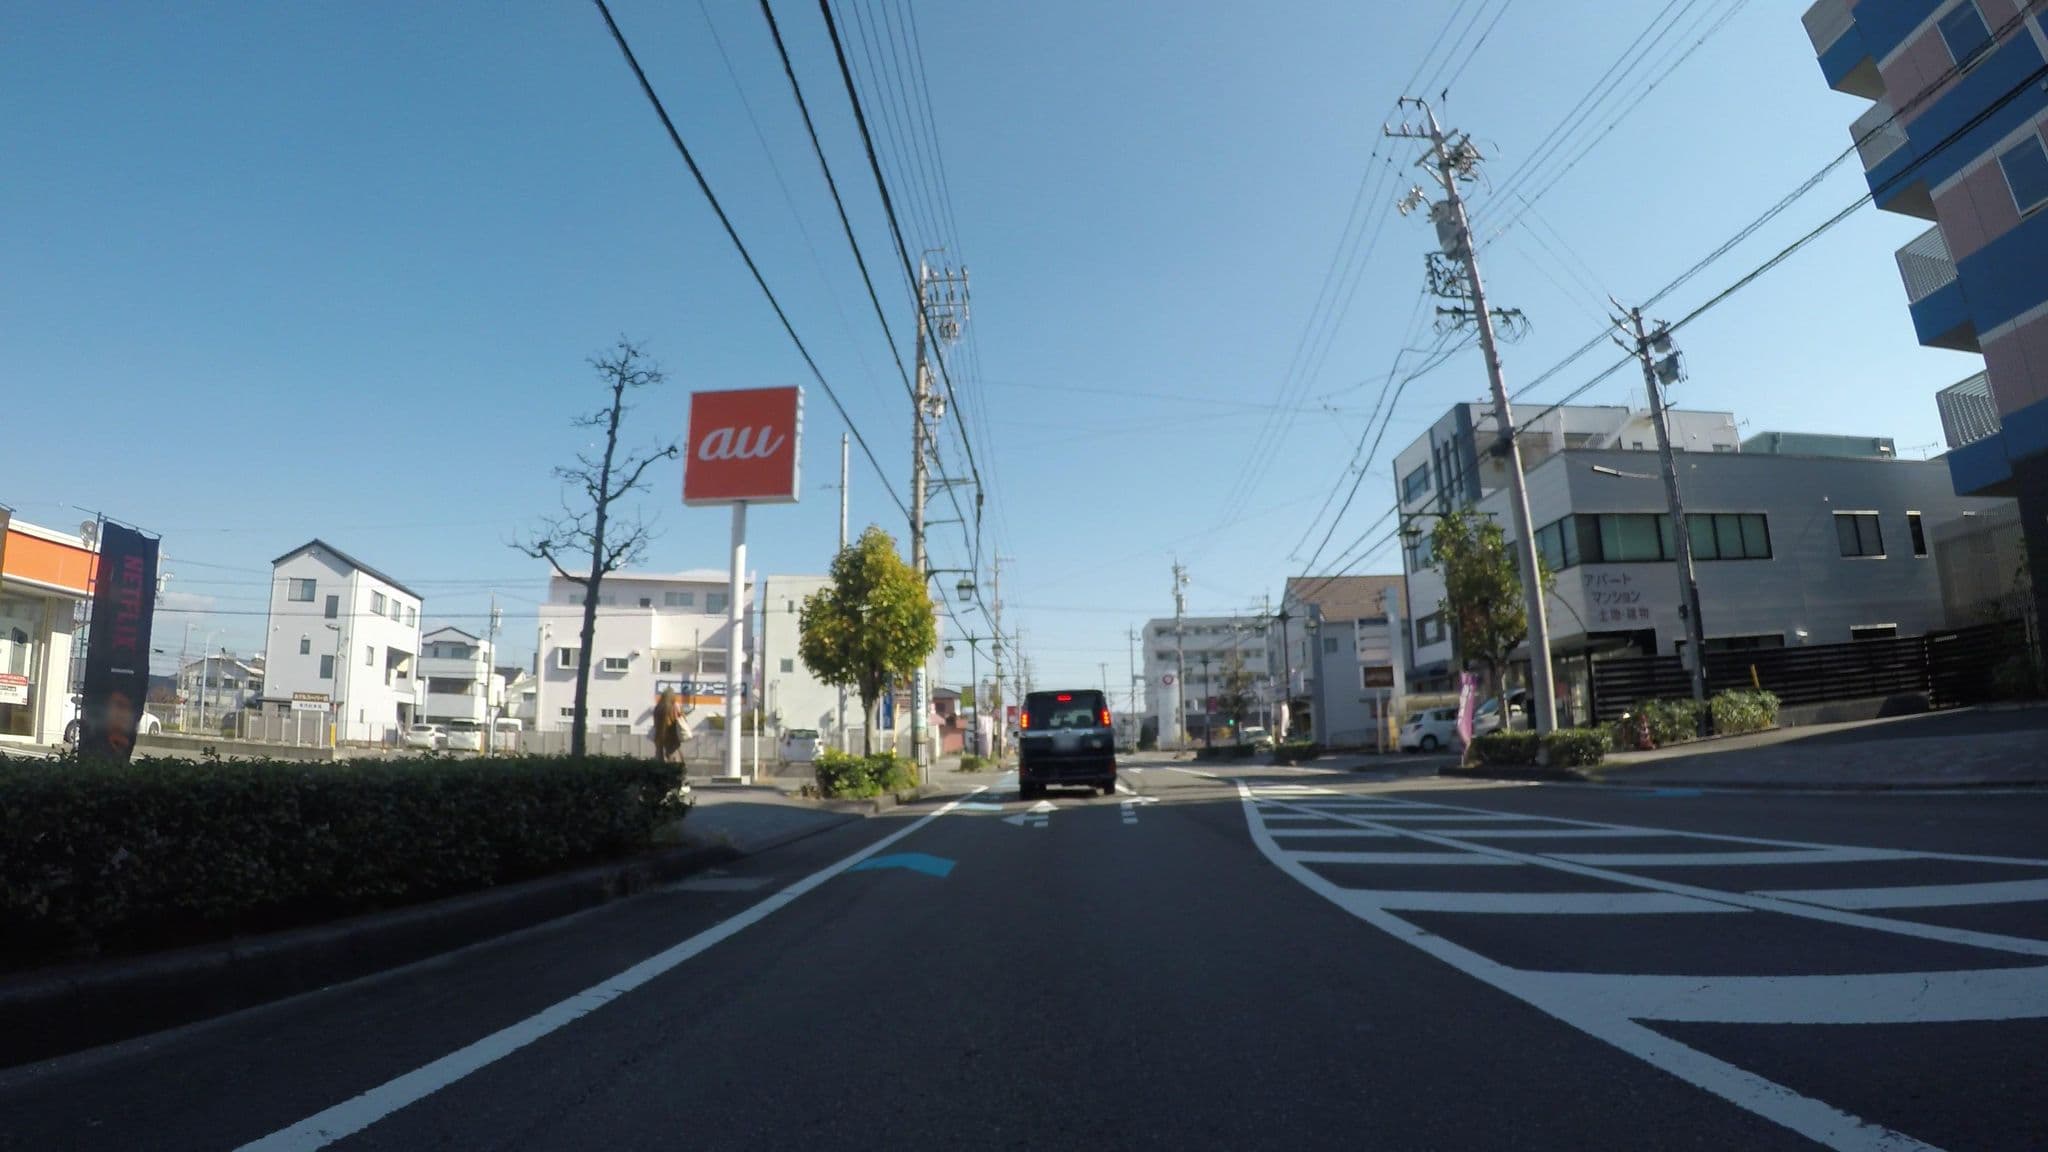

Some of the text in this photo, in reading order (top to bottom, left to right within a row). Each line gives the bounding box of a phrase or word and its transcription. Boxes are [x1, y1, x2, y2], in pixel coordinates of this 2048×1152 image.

[698, 425, 785, 461] au
[1583, 571, 1632, 587] アパート
[1591, 589, 1641, 607] マンション
